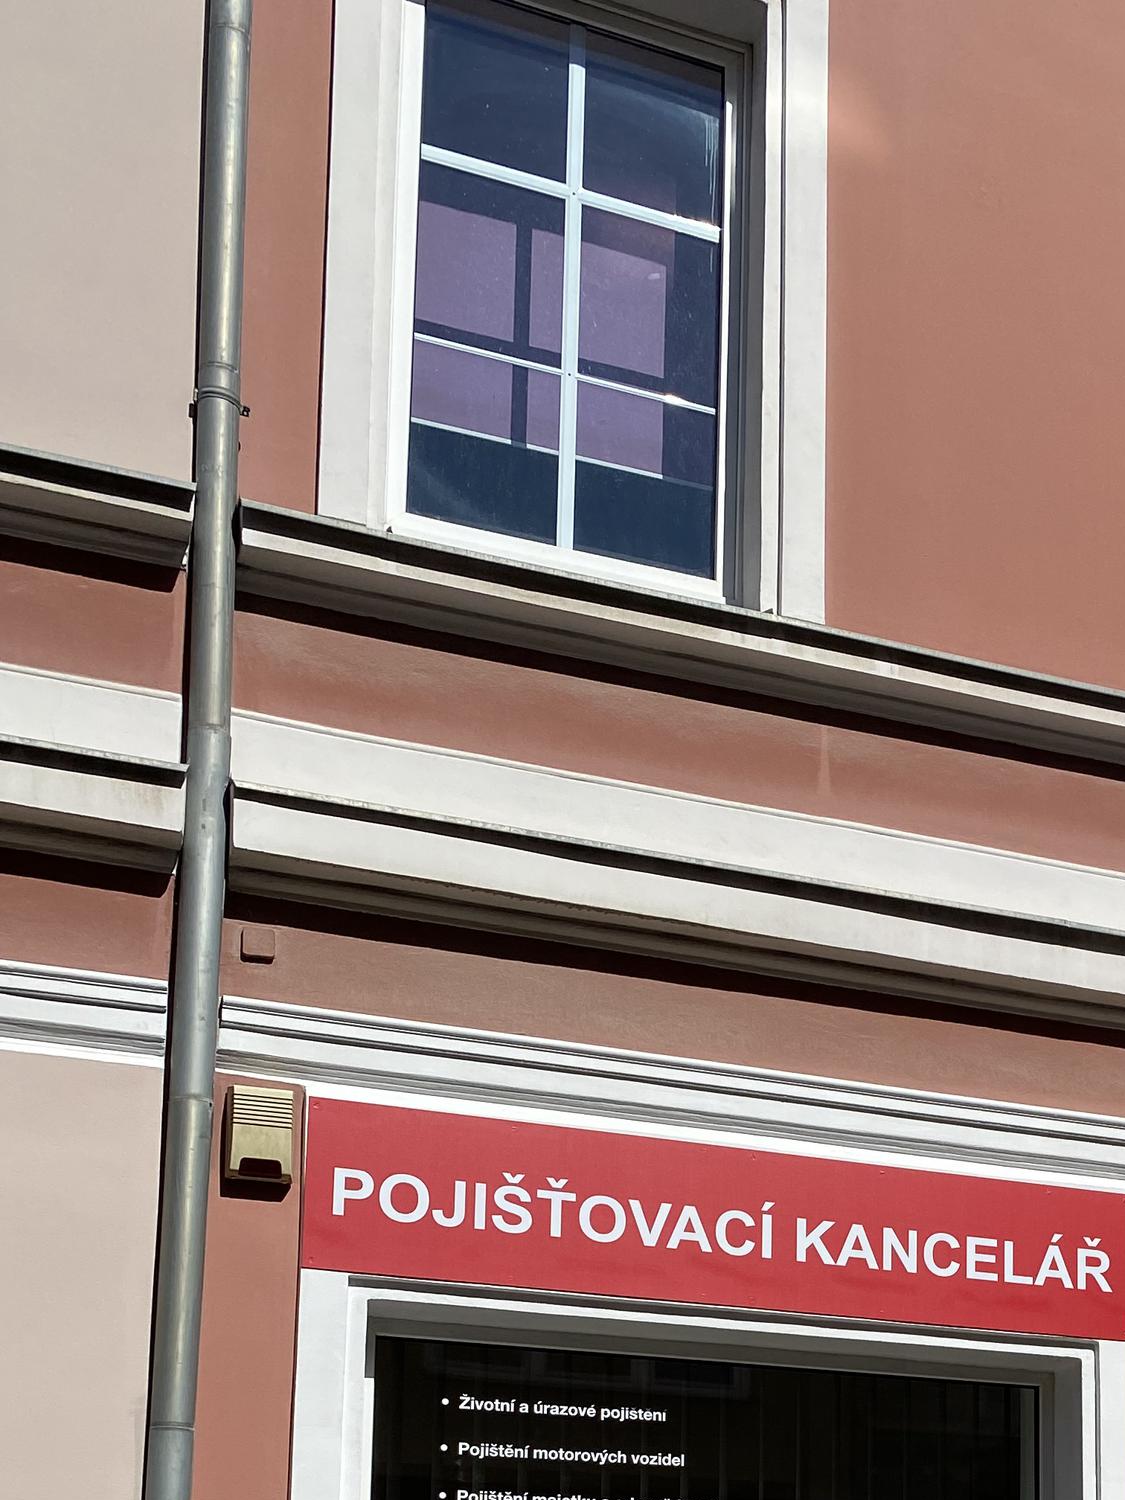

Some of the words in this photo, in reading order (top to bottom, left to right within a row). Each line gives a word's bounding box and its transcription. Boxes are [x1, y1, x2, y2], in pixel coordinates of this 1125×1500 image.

[330, 1166, 775, 1260] POJIŠŤOVACÍ
[795, 1216, 1112, 1294] KANCELÁŘ
[458, 1394, 516, 1412] Životní
[519, 1403, 529, 1414] a
[534, 1400, 596, 1418] úrazové
[600, 1406, 668, 1422] pojištění
[458, 1442, 530, 1459] Pojištění
[533, 1448, 627, 1465] motorových
[632, 1452, 685, 1467] vozidel
